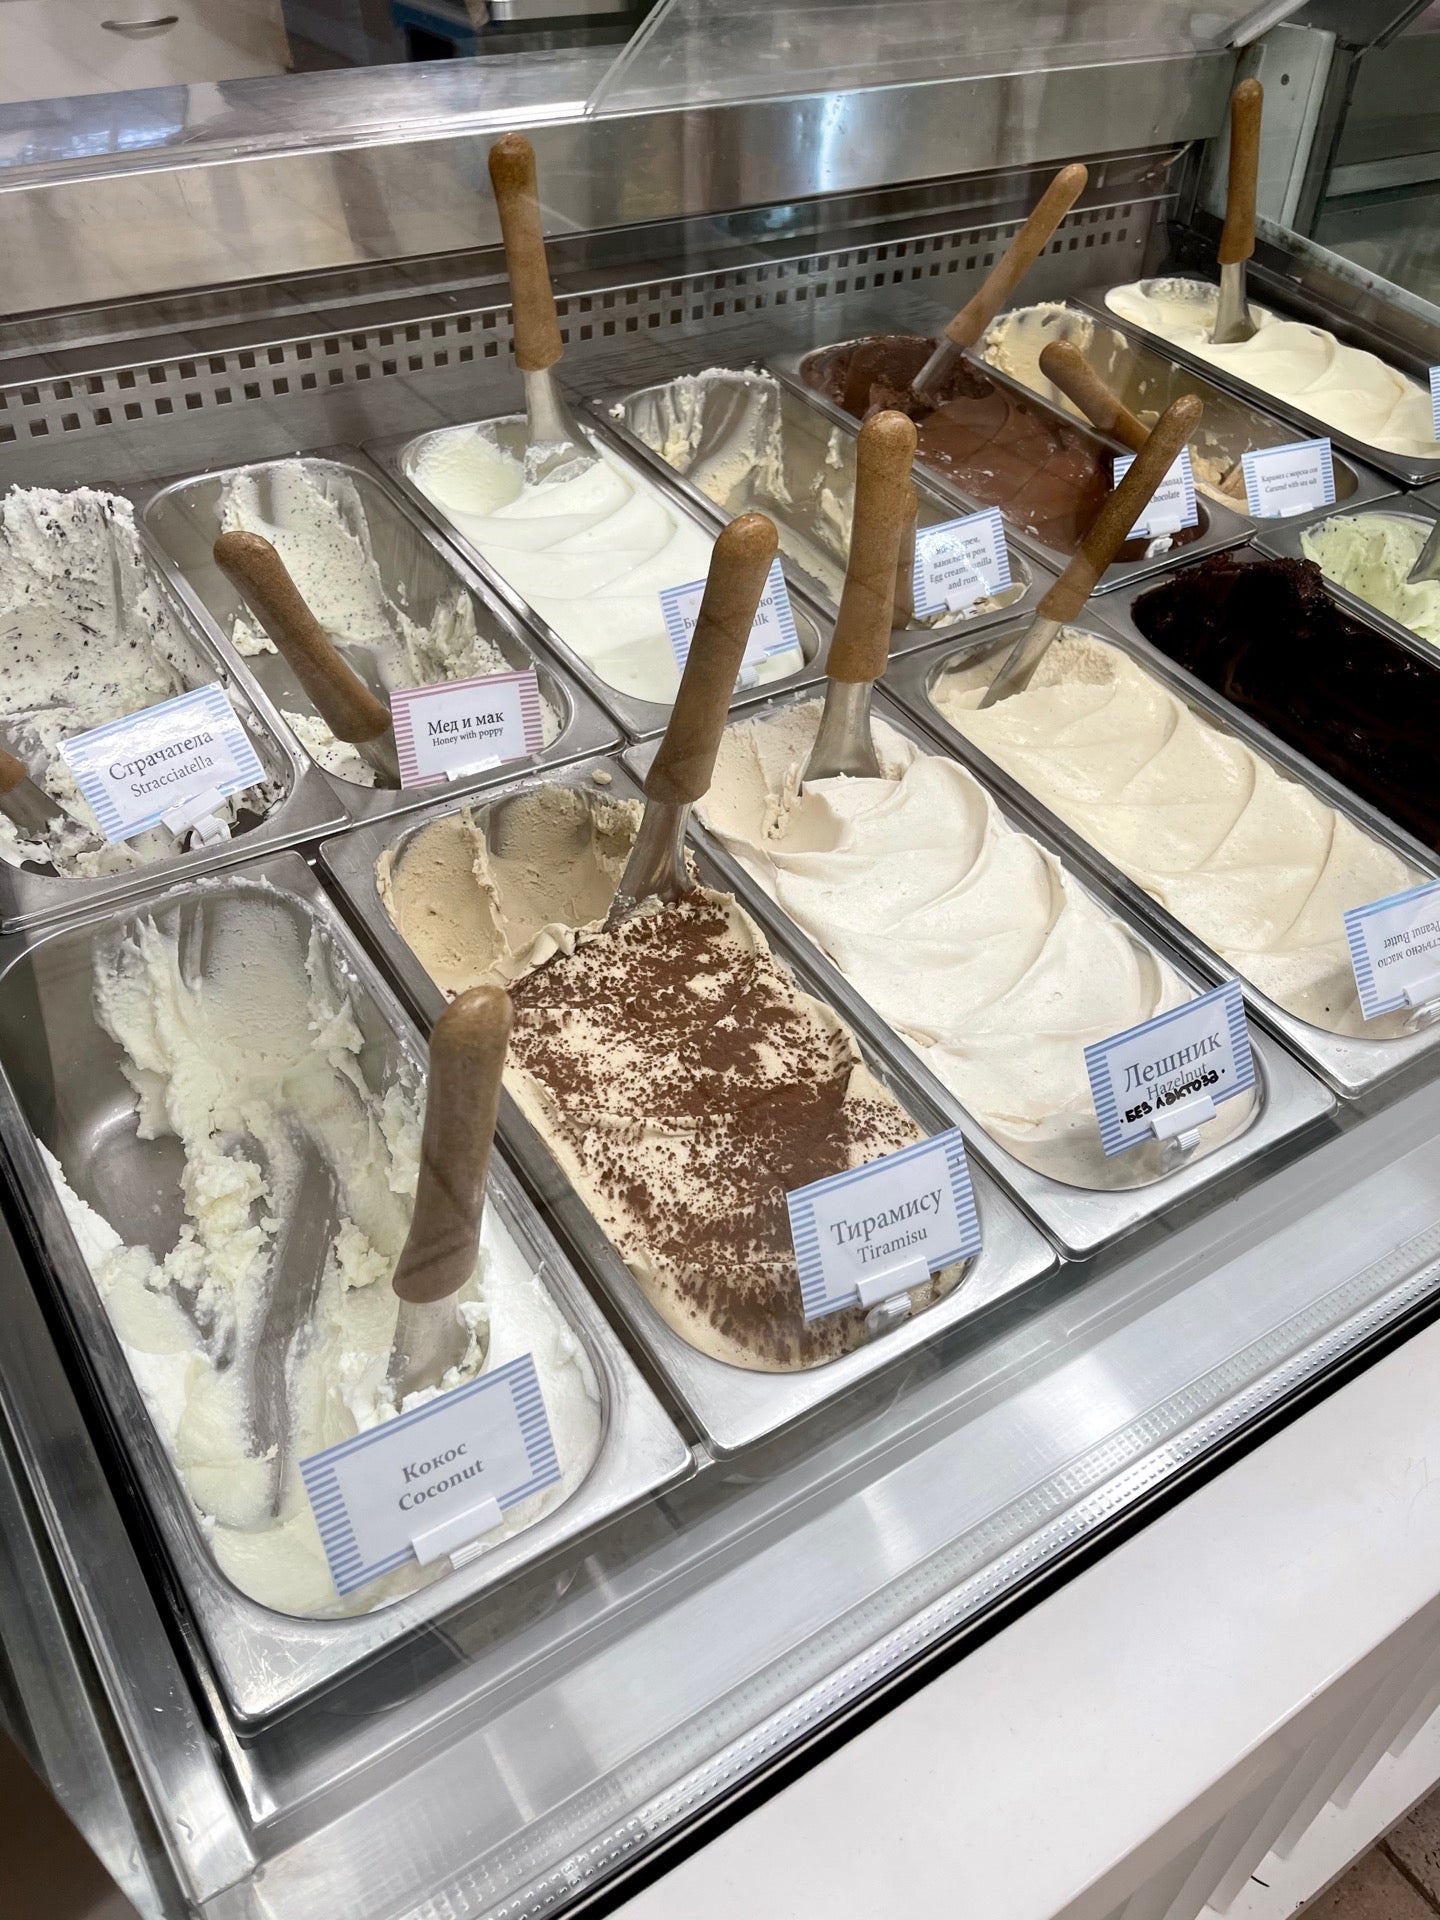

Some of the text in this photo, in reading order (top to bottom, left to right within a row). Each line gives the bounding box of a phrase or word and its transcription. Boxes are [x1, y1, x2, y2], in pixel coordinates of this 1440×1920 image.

[1264, 482, 1287, 493] Caramel
[1288, 480, 1299, 488] with
[1308, 477, 1317, 485] salt
[930, 574, 944, 585] Egg
[948, 574, 979, 590] and rum
[427, 711, 505, 737] Мед и мак
[432, 727, 504, 747] Honey with poppy
[108, 731, 214, 782] Страчатела
[130, 755, 214, 798] Stracciatella
[1383, 920, 1440, 949] Peanut Butter
[1377, 952, 1403, 969] масло
[1124, 1032, 1222, 1093] Лешник
[1147, 1062, 1208, 1101] Hazelnut
[830, 1188, 943, 1247] Тирамису
[857, 1227, 928, 1264] Tiramisu
[401, 1442, 468, 1485] Кокос
[398, 1458, 485, 1512] Coconut
